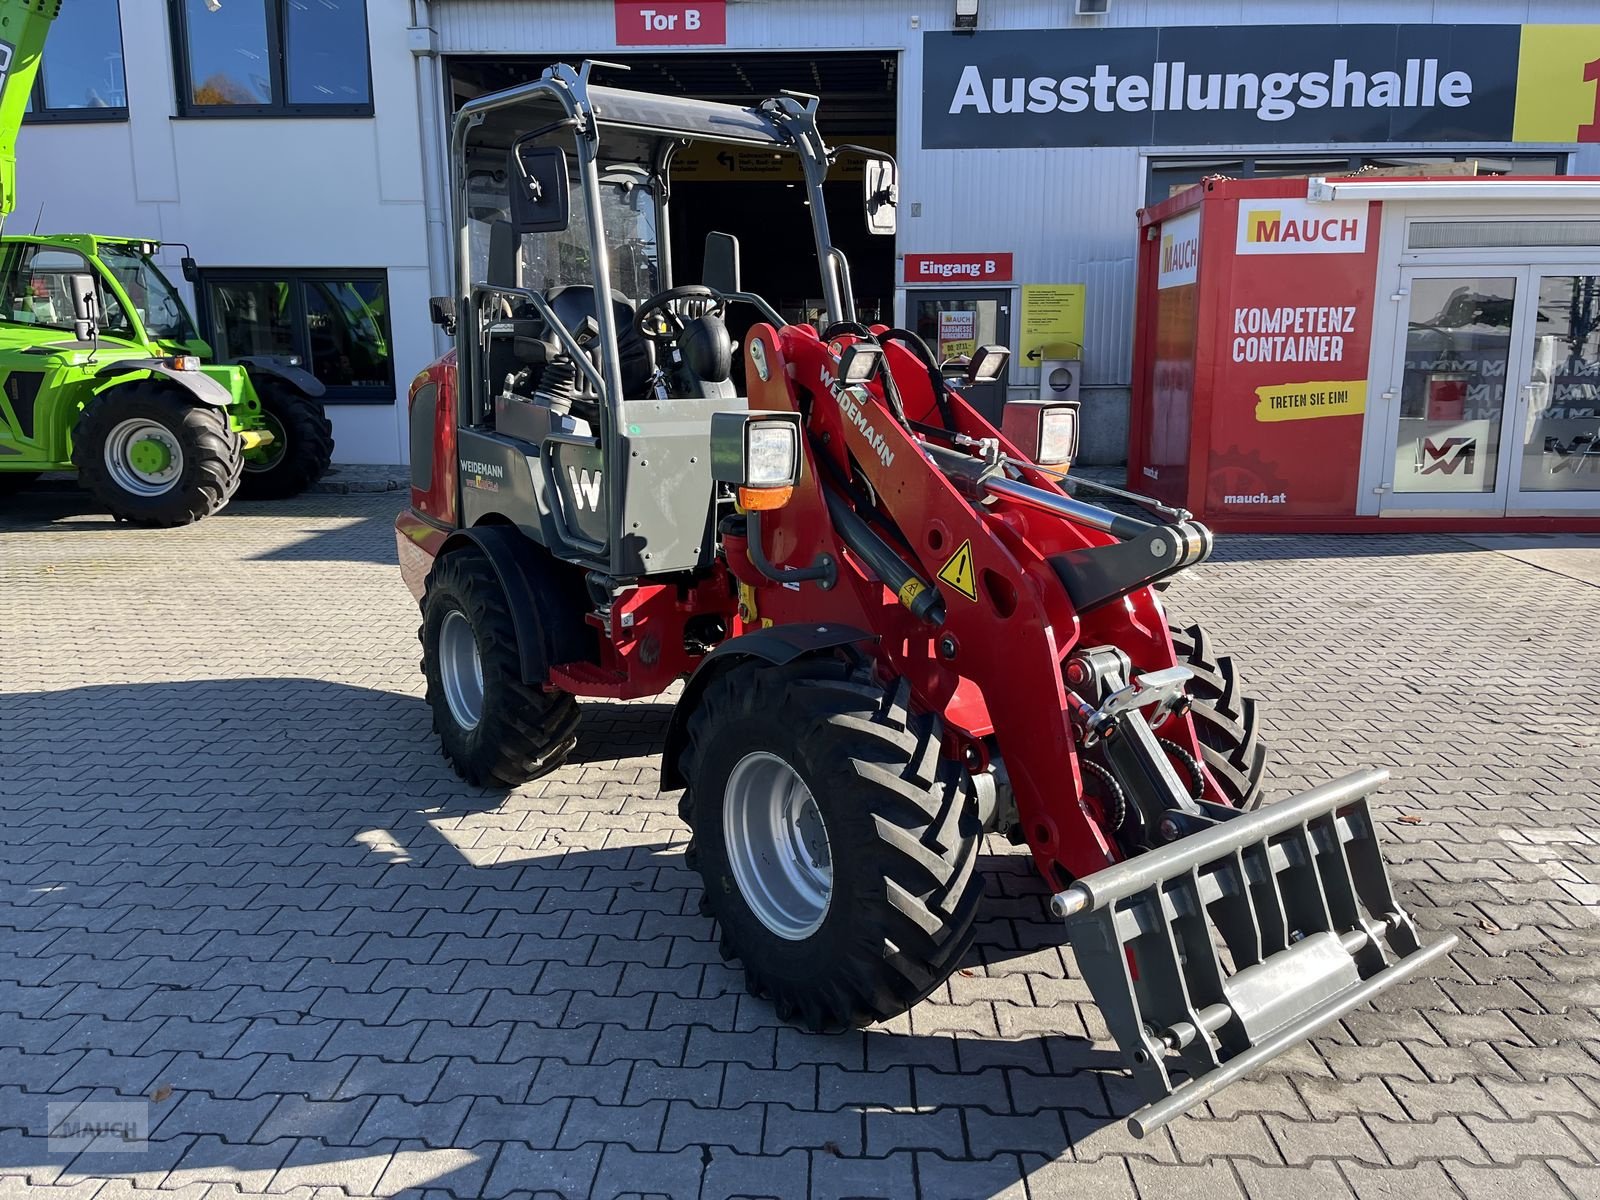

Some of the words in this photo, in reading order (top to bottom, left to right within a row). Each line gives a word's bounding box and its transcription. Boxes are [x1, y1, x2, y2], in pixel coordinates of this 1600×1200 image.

[640, 10, 677, 30] Tor
[685, 10, 700, 30] B
[949, 58, 1473, 121] Ausstellungshalle
[1256, 219, 1358, 242] MAUCH
[1164, 238, 1197, 272] MAUCH
[919, 261, 981, 276] Eingang
[985, 261, 996, 273] B
[1234, 306, 1356, 334] KOMPETENZ
[1232, 335, 1343, 363] CONTAINER
[1270, 393, 1307, 409] TRETEN
[1309, 392, 1325, 405] SIE
[1329, 391, 1348, 404] EIN!
[819, 364, 895, 467] WEIDEMANN
[460, 459, 503, 478] WEIDEMANN
[567, 465, 603, 513] W
[1224, 492, 1287, 504] mauch.at
